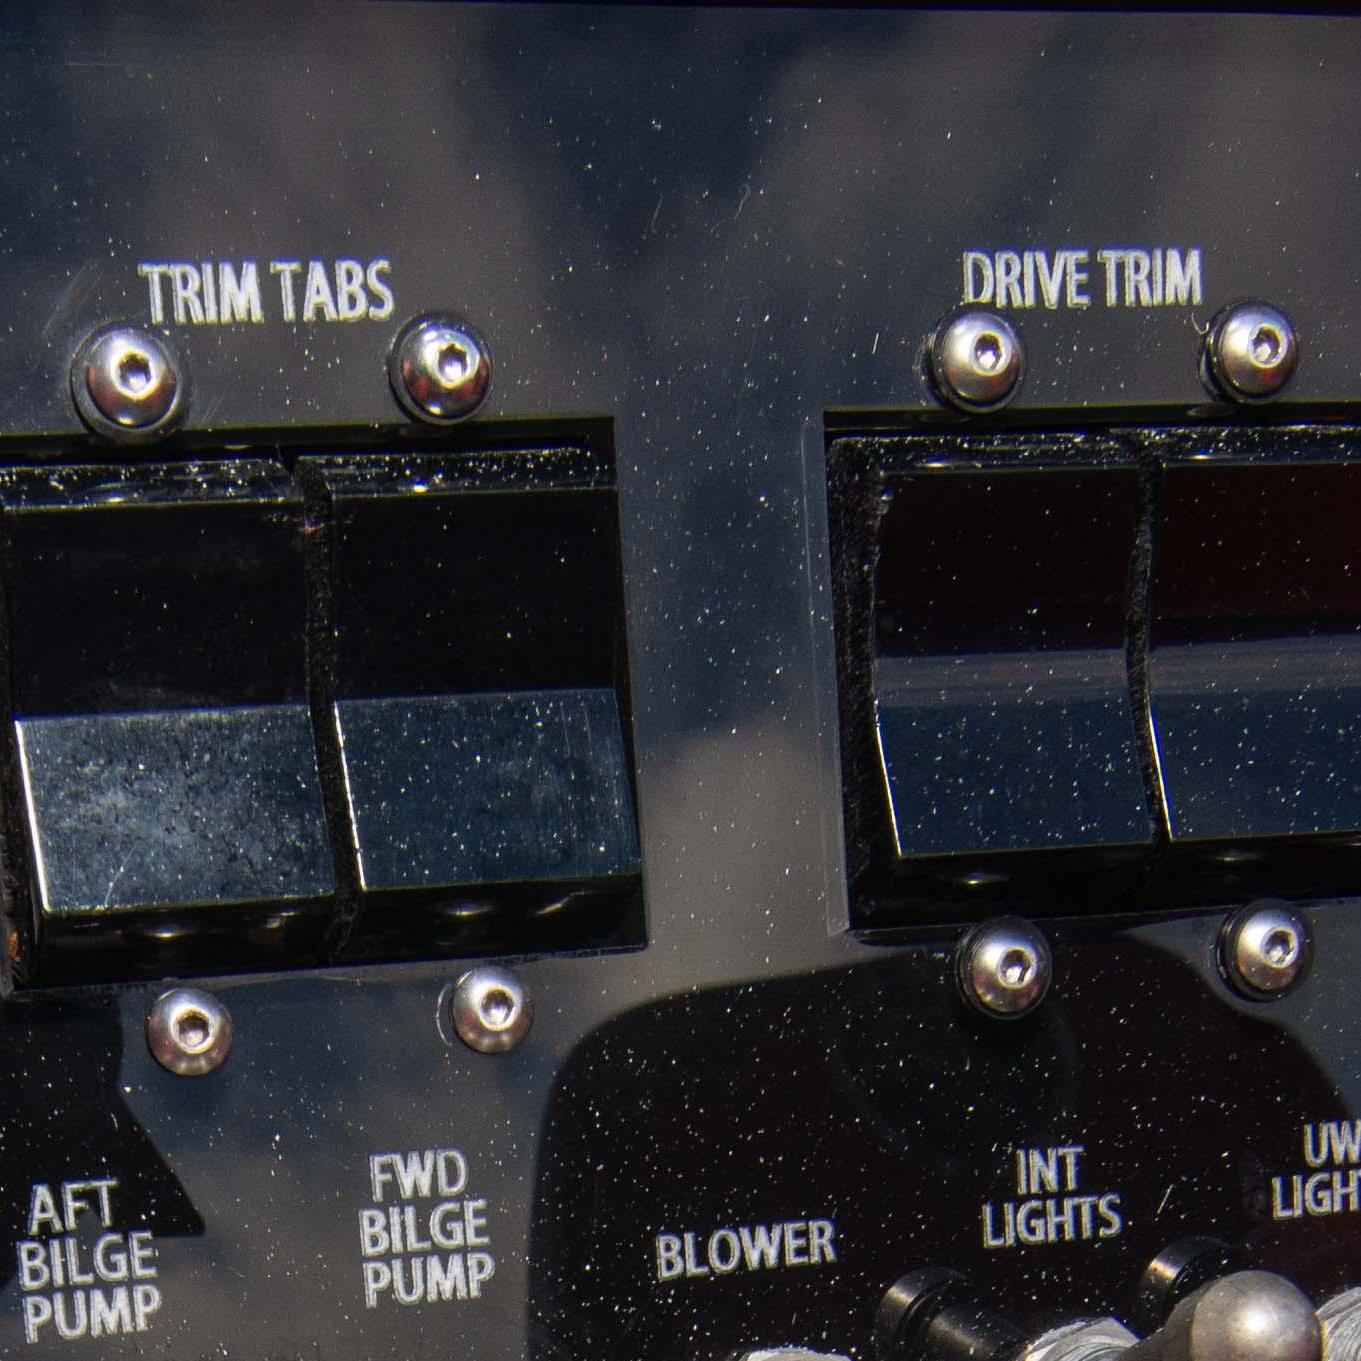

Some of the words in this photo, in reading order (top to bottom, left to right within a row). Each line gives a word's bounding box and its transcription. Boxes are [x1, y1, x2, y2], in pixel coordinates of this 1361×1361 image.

[138, 261, 263, 326] TRIM
[270, 259, 395, 324] TABS
[963, 250, 1092, 310] DRIVE
[1096, 247, 1203, 307] TRIM
[368, 1148, 470, 1202] FWD
[1016, 1145, 1086, 1195] INT
[27, 1178, 120, 1237] AFT
[358, 1199, 491, 1259] BILGE
[980, 1194, 1123, 1249] LIGHTS
[16, 1232, 158, 1293] BILGE
[361, 1252, 496, 1308] PUMP
[655, 1218, 837, 1282] BLOWER
[21, 1284, 163, 1345] PUMP
